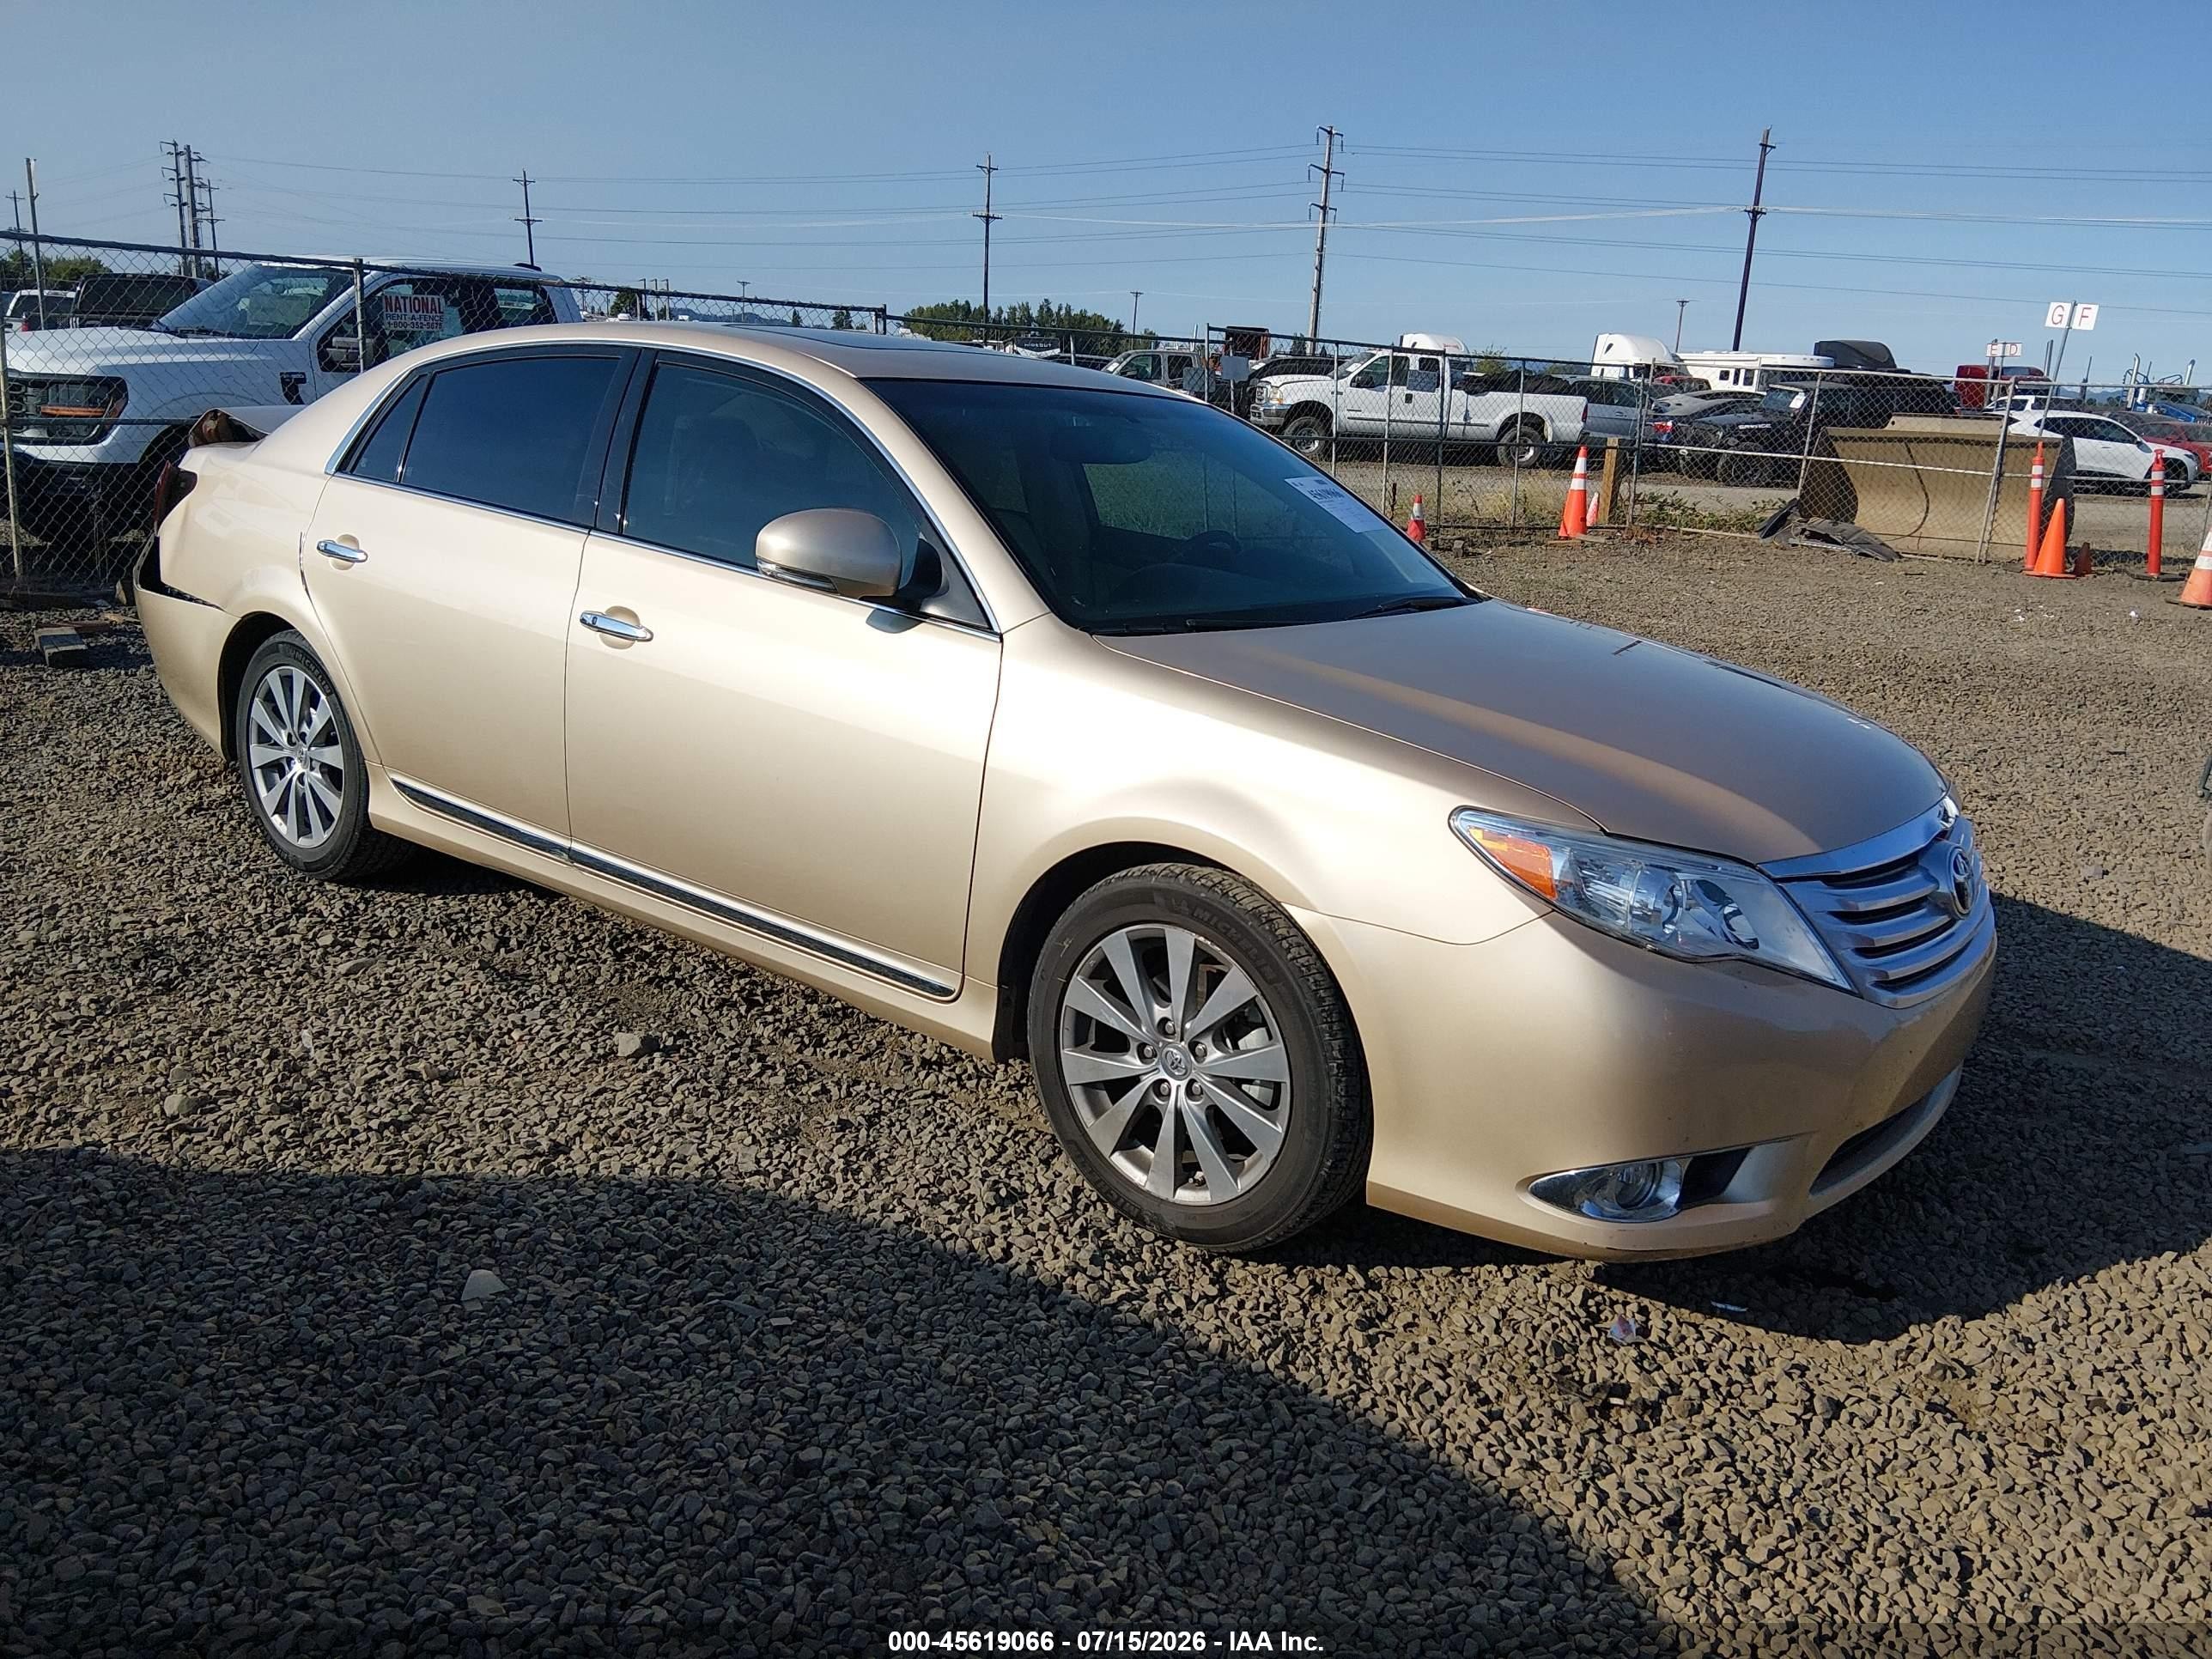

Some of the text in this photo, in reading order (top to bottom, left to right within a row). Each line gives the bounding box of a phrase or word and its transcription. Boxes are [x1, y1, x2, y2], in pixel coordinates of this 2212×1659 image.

[385, 295, 444, 314] NATIONAL
[2051, 305, 2064, 325] G
[2078, 307, 2092, 326] F
[1990, 343, 1998, 356] E
[2009, 343, 2018, 356] D
